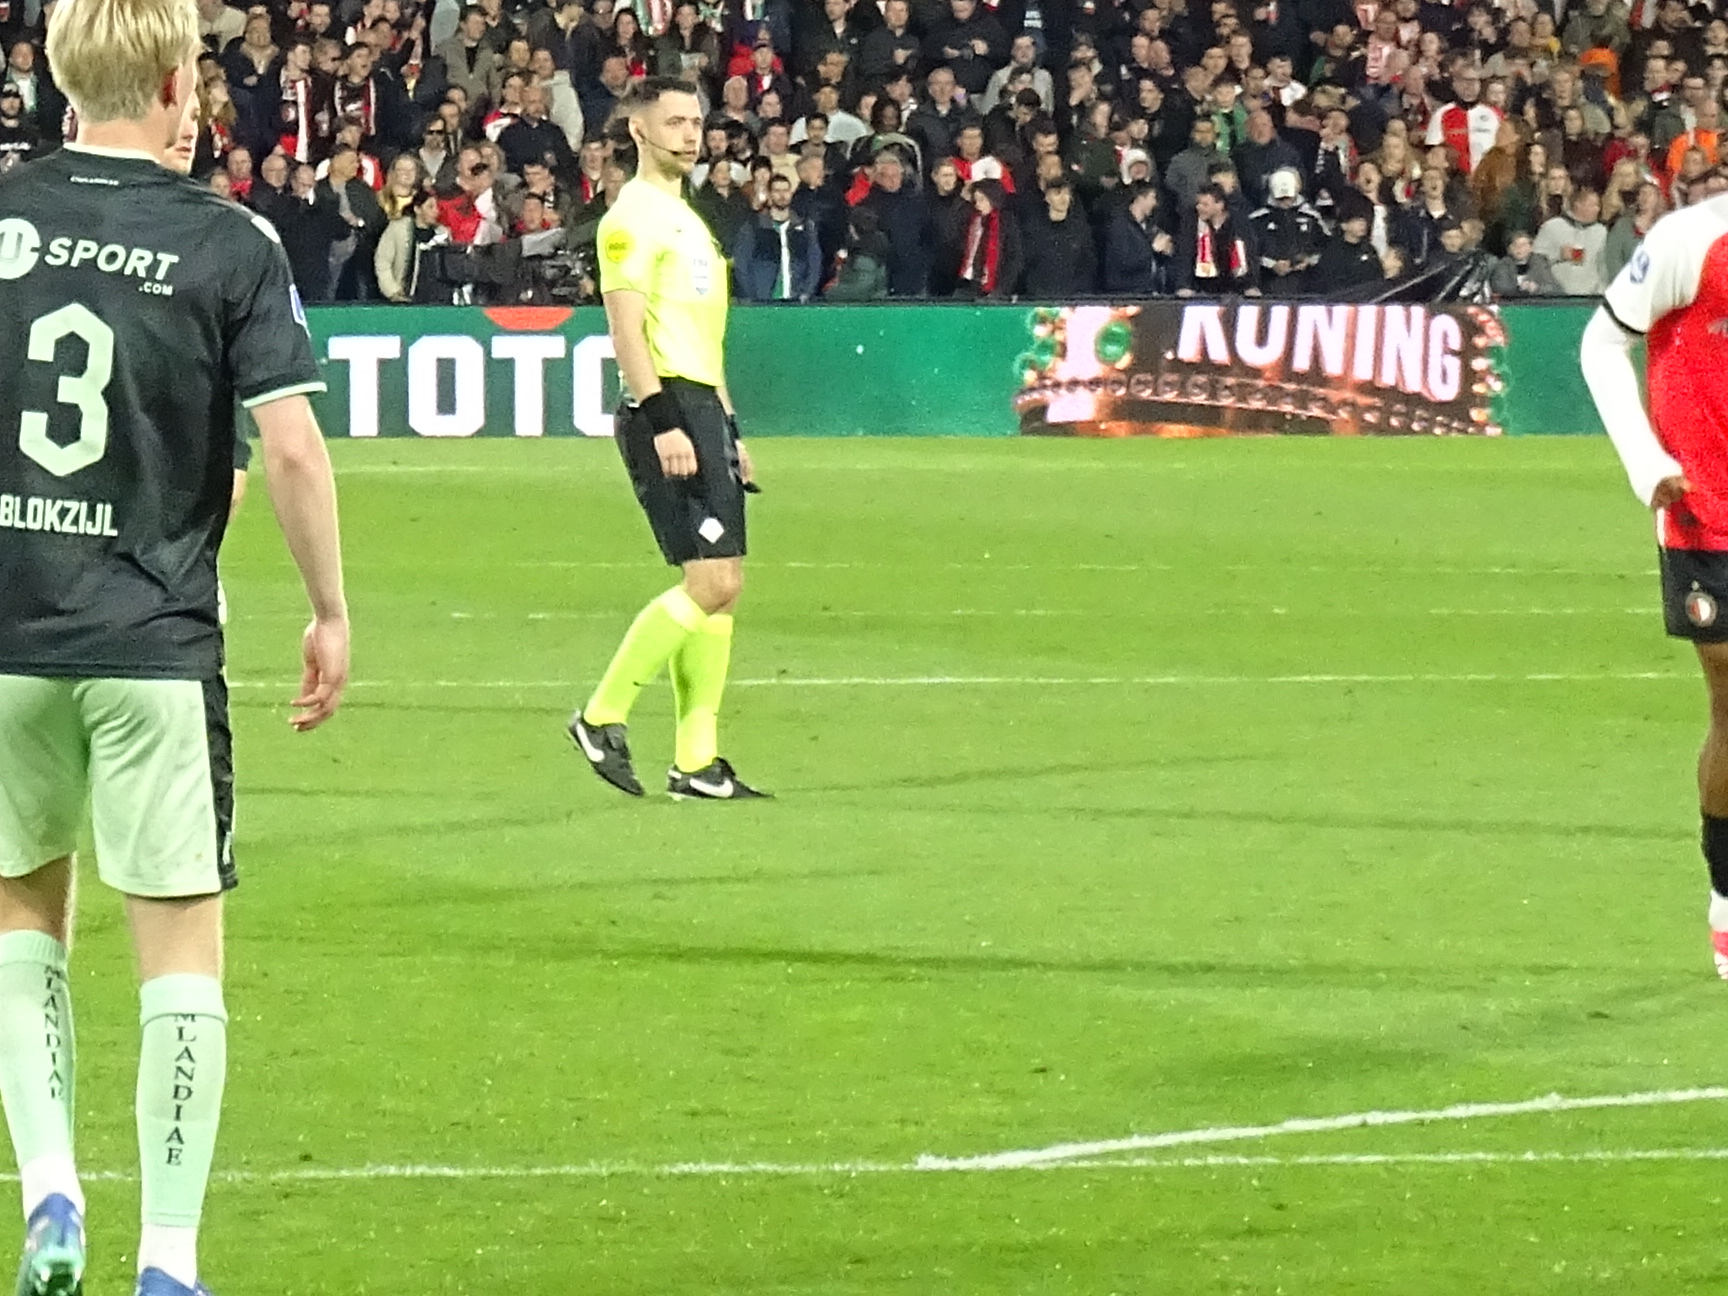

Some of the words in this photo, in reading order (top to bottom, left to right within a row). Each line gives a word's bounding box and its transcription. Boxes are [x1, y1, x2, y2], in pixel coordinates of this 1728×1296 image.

[44, 238, 179, 281] SPORT
[19, 303, 114, 477] 3
[0, 493, 118, 536] BLOKZIJL
